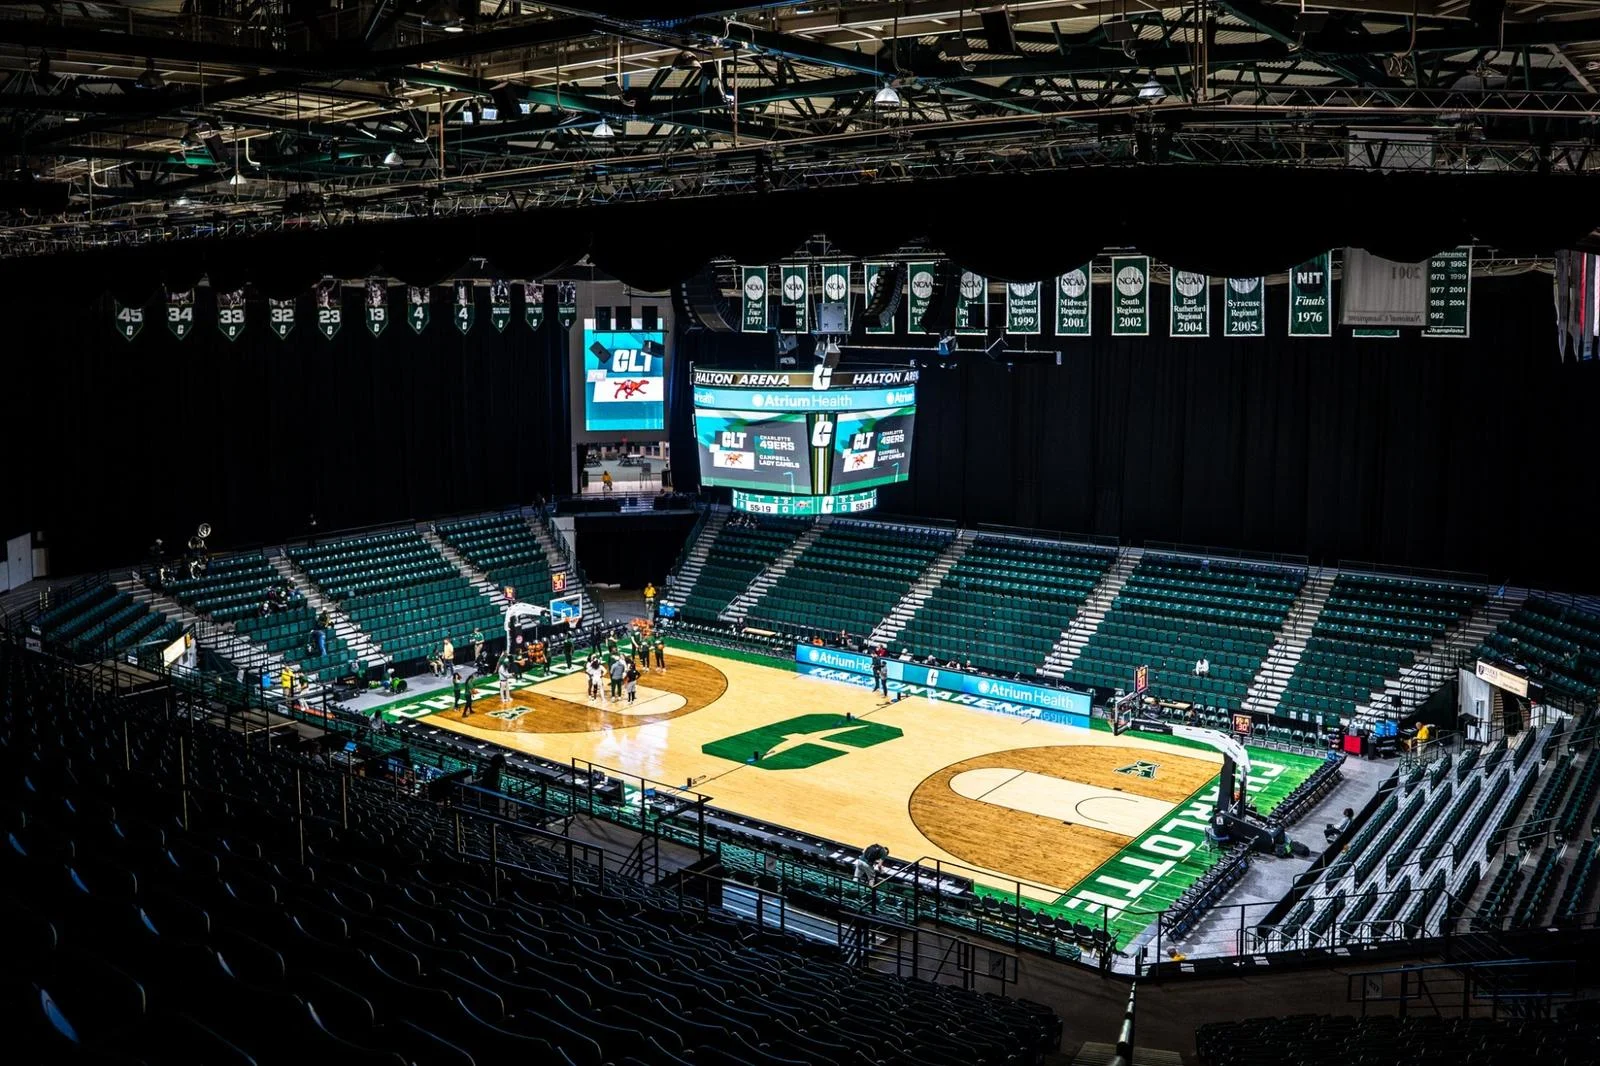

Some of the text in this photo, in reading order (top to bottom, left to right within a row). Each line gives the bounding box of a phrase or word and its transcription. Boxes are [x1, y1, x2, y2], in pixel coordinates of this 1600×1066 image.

[1062, 277, 1085, 286] NCAA
[1118, 276, 1142, 284] NCAA
[1296, 272, 1323, 284] NIT
[1010, 298, 1037, 306] Midwest
[1060, 298, 1087, 306] Midwest
[1228, 300, 1260, 308] Syracuse
[1295, 296, 1325, 306] Finals
[118, 308, 143, 322] 45
[168, 308, 192, 322] 34
[220, 310, 244, 323] 33
[272, 310, 294, 322] 32
[319, 310, 341, 322] 23
[369, 308, 384, 320] 13
[414, 307, 424, 319] 4
[458, 308, 468, 320] 4
[1011, 307, 1037, 315] Regional
[1060, 308, 1087, 316] Regional
[1116, 307, 1144, 315] Regional
[1231, 309, 1258, 318] Regional
[746, 317, 762, 325] 1977
[1013, 317, 1034, 326] 1999
[1120, 317, 1142, 327] 2002
[1178, 313, 1203, 321] Regional
[1297, 312, 1322, 323] 1976
[1062, 318, 1084, 328] 2001
[1178, 322, 1203, 332] 2004
[1232, 321, 1258, 332] 2005
[612, 349, 652, 372] CLT
[696, 372, 790, 386] HALTON ARENA
[852, 372, 901, 384] HALTON
[764, 394, 853, 408] Atrium Health
[722, 431, 747, 448] CLT
[853, 432, 874, 450] CLT
[880, 434, 905, 444] 49ERS
[759, 441, 796, 451] 49ERS
[759, 454, 790, 462] CAMPBELL
[819, 650, 855, 670] Atrium
[989, 682, 1073, 710] Atrium Health
[932, 689, 1042, 718] ARENA
